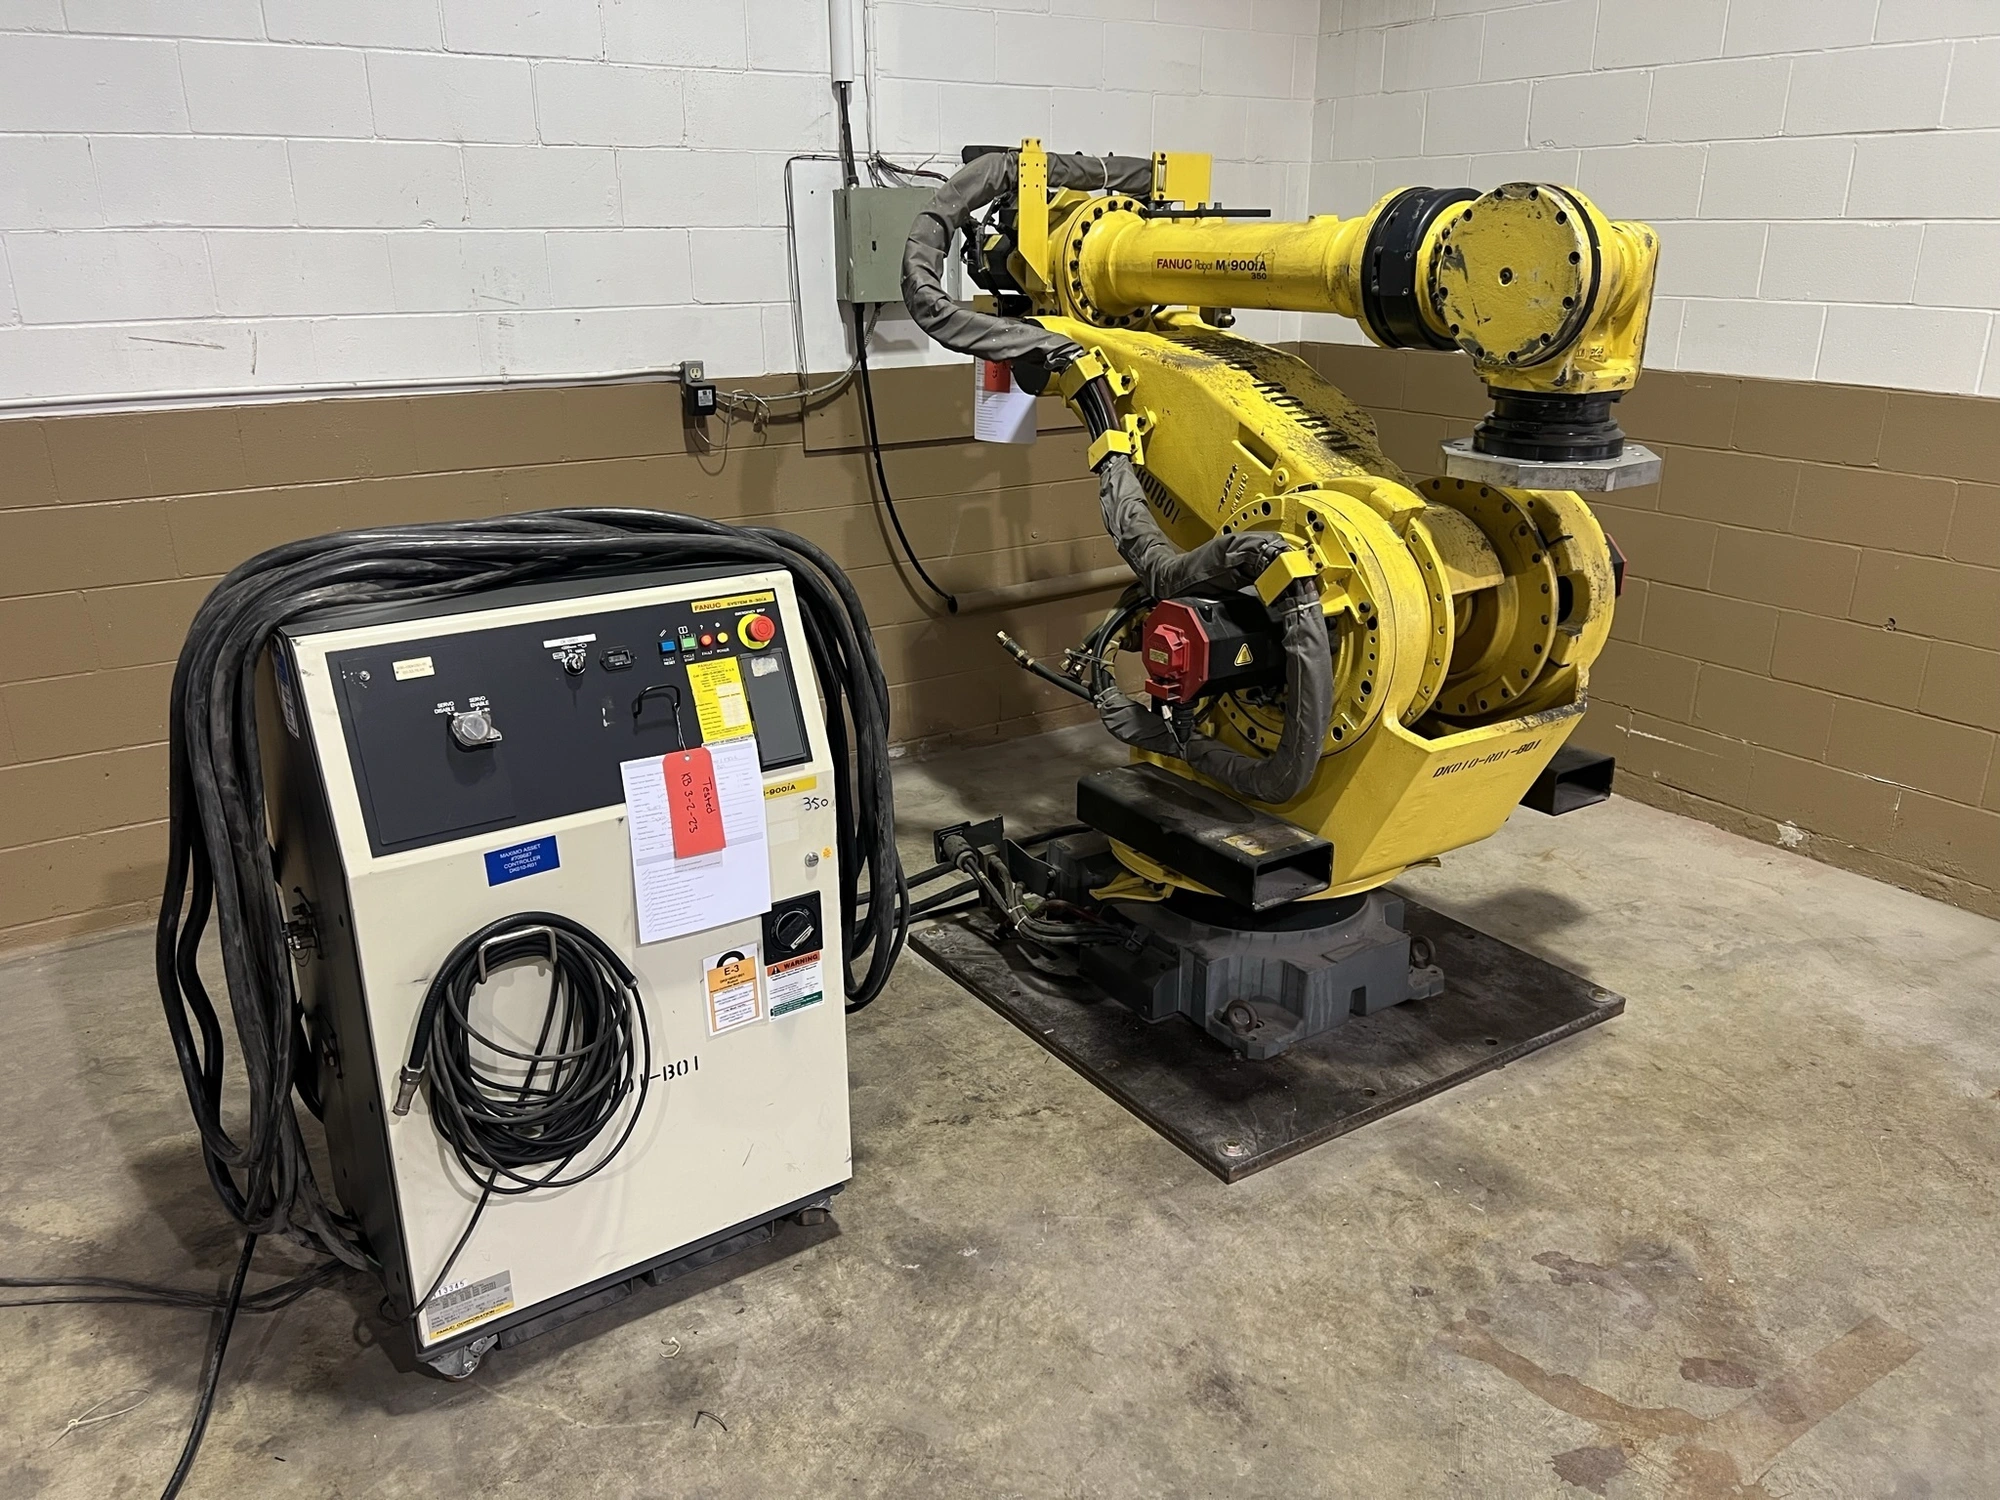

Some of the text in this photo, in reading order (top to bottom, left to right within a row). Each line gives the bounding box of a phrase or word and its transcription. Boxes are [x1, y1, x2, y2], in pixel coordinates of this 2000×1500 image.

[1157, 259, 1192, 270] FANUC
[1251, 272, 1267, 280] 350
[694, 602, 721, 612] FANUC
[469, 695, 486, 703] SERVO
[470, 700, 489, 708] ENABLE
[434, 706, 455, 714] DISABLE
[437, 701, 454, 709] SERVO
[1432, 739, 1542, 778] DK010-R01-B01
[702, 777, 716, 814] Tested
[681, 772, 698, 834] KB 3-2-23
[803, 797, 829, 811] 350
[500, 843, 541, 859] MAXIMO ASSET
[503, 855, 541, 869] CONTROLLER
[803, 908, 811, 916] ON
[783, 954, 818, 970] WARNING
[724, 964, 740, 976] E-3
[433, 1281, 465, 1298] 13345
[436, 1325, 456, 1334] FANUC
